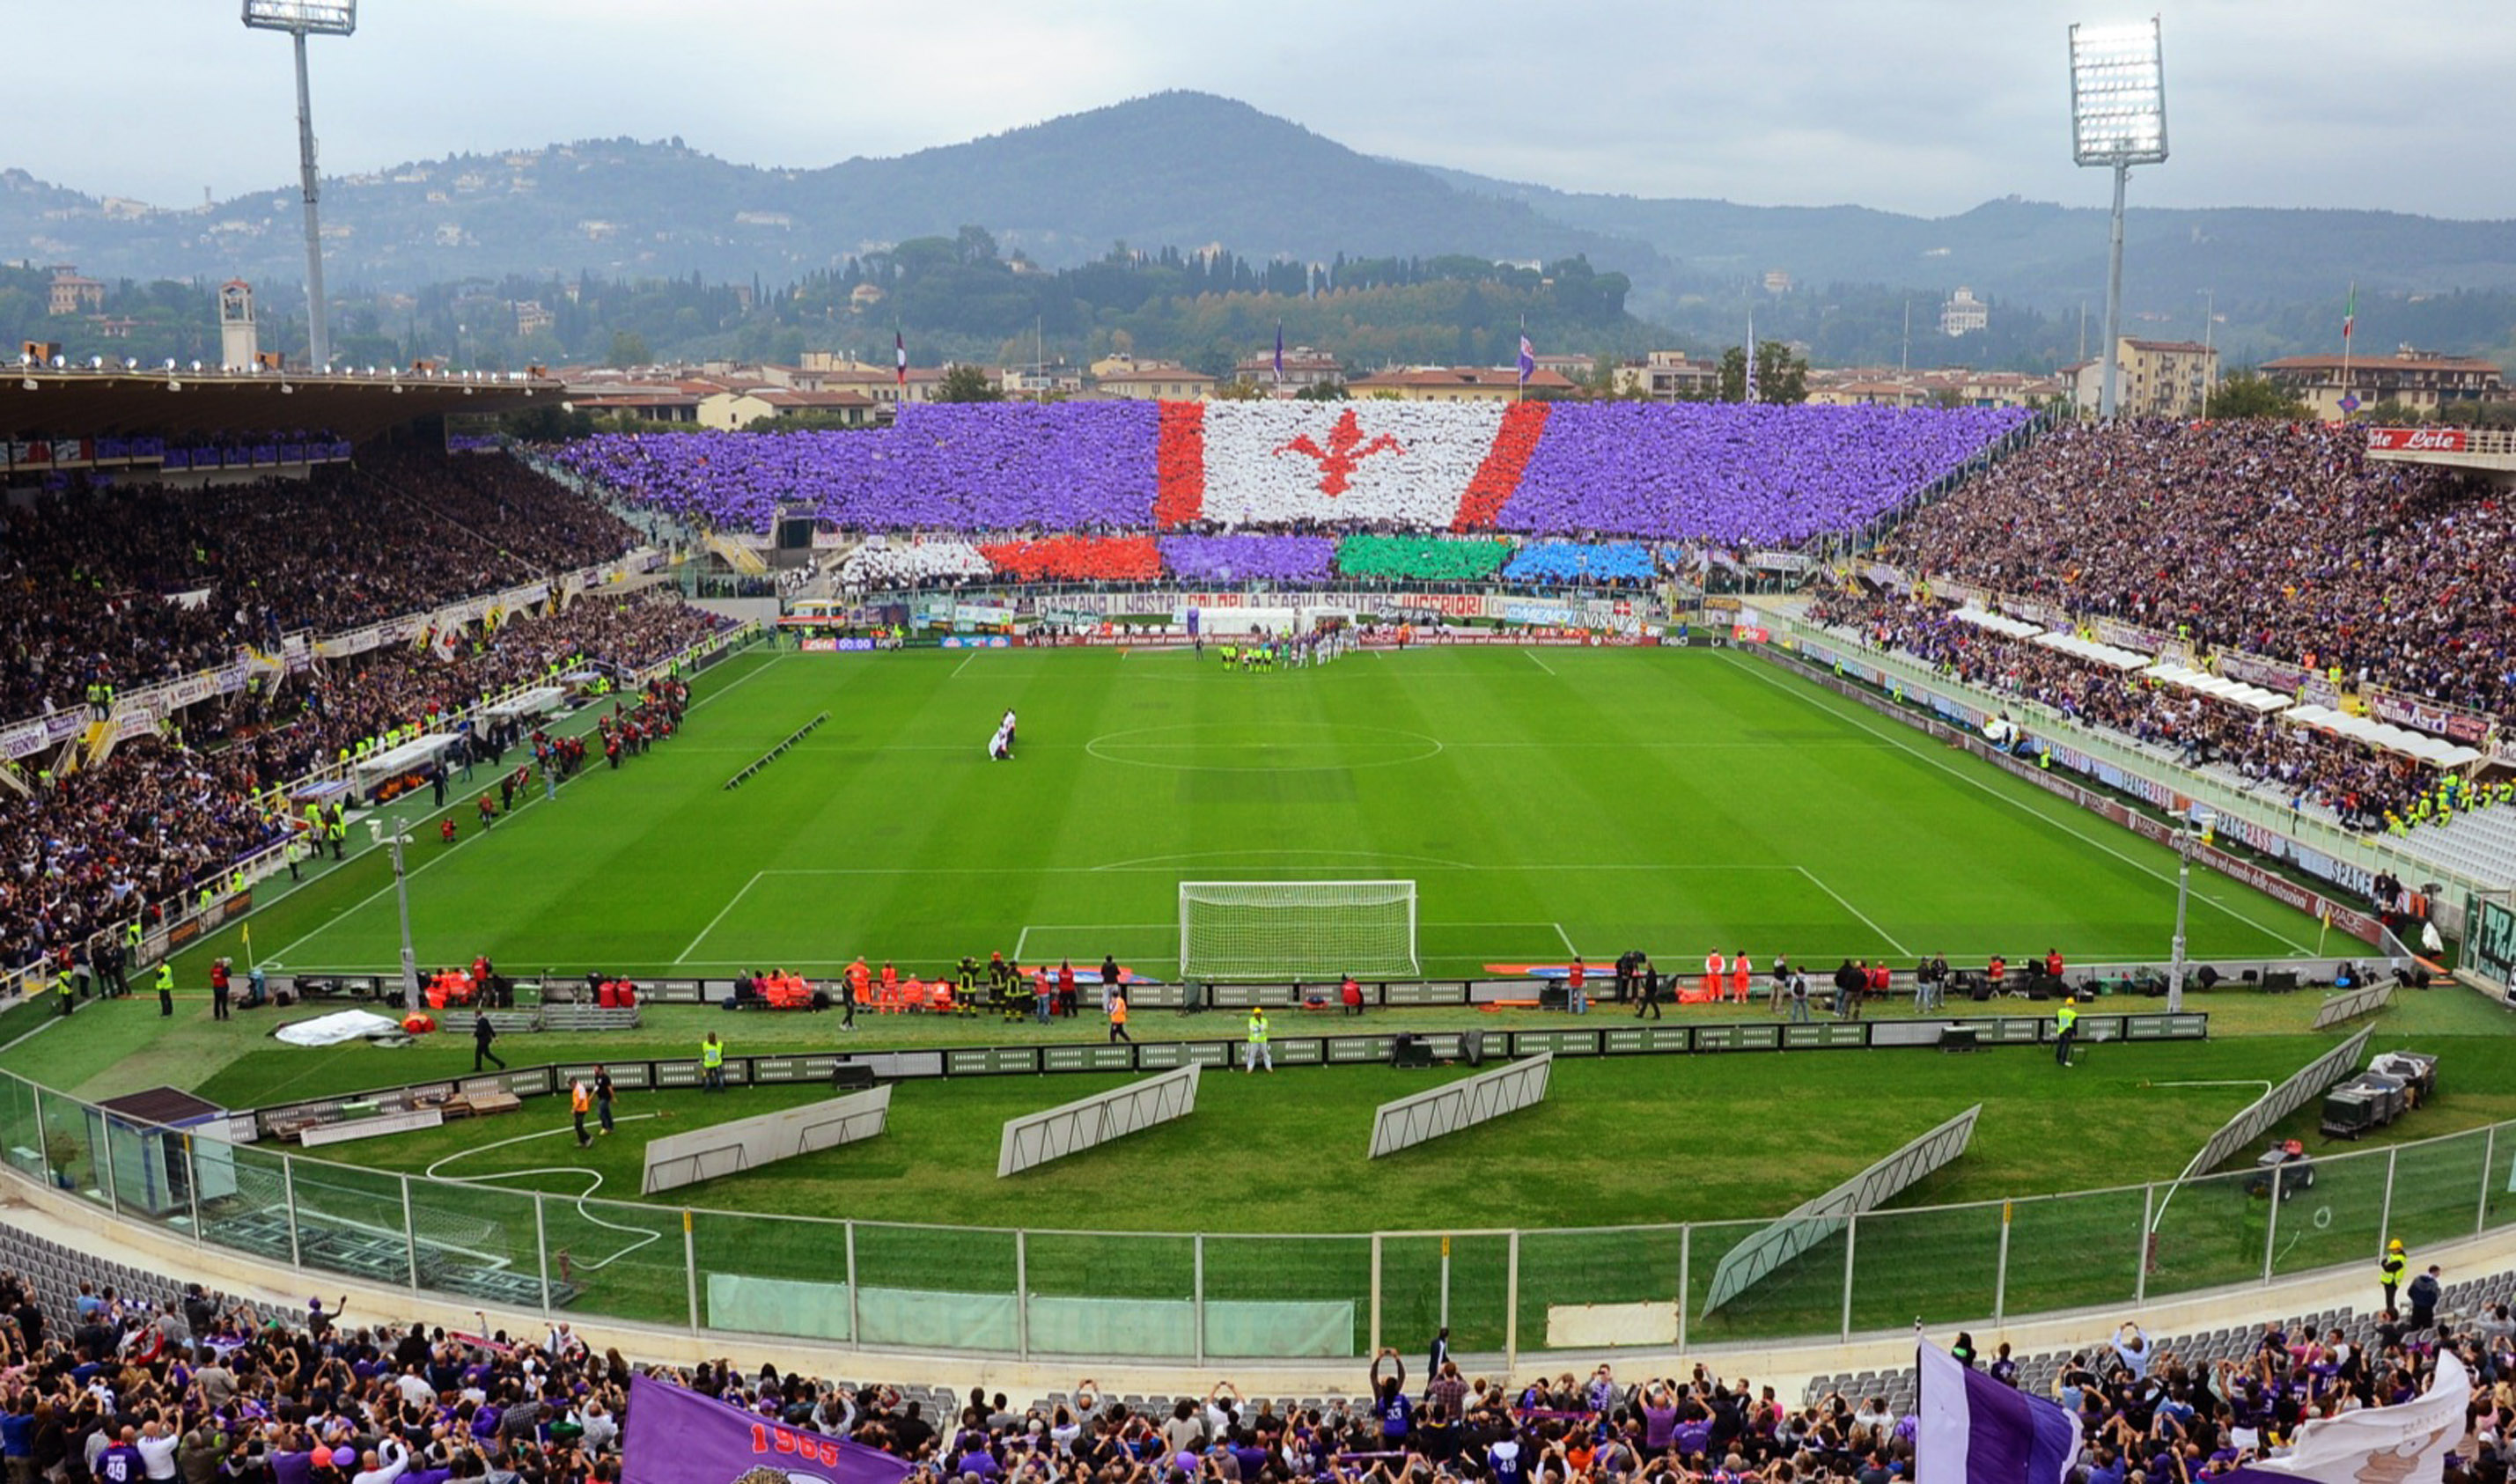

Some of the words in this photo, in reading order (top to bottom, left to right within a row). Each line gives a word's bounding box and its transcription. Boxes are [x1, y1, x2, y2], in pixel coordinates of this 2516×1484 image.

[2402, 430, 2455, 449] Lete
[752, 1423, 840, 1468] 1965
[107, 1461, 127, 1482] 49
[1500, 1459, 1517, 1473] 49
